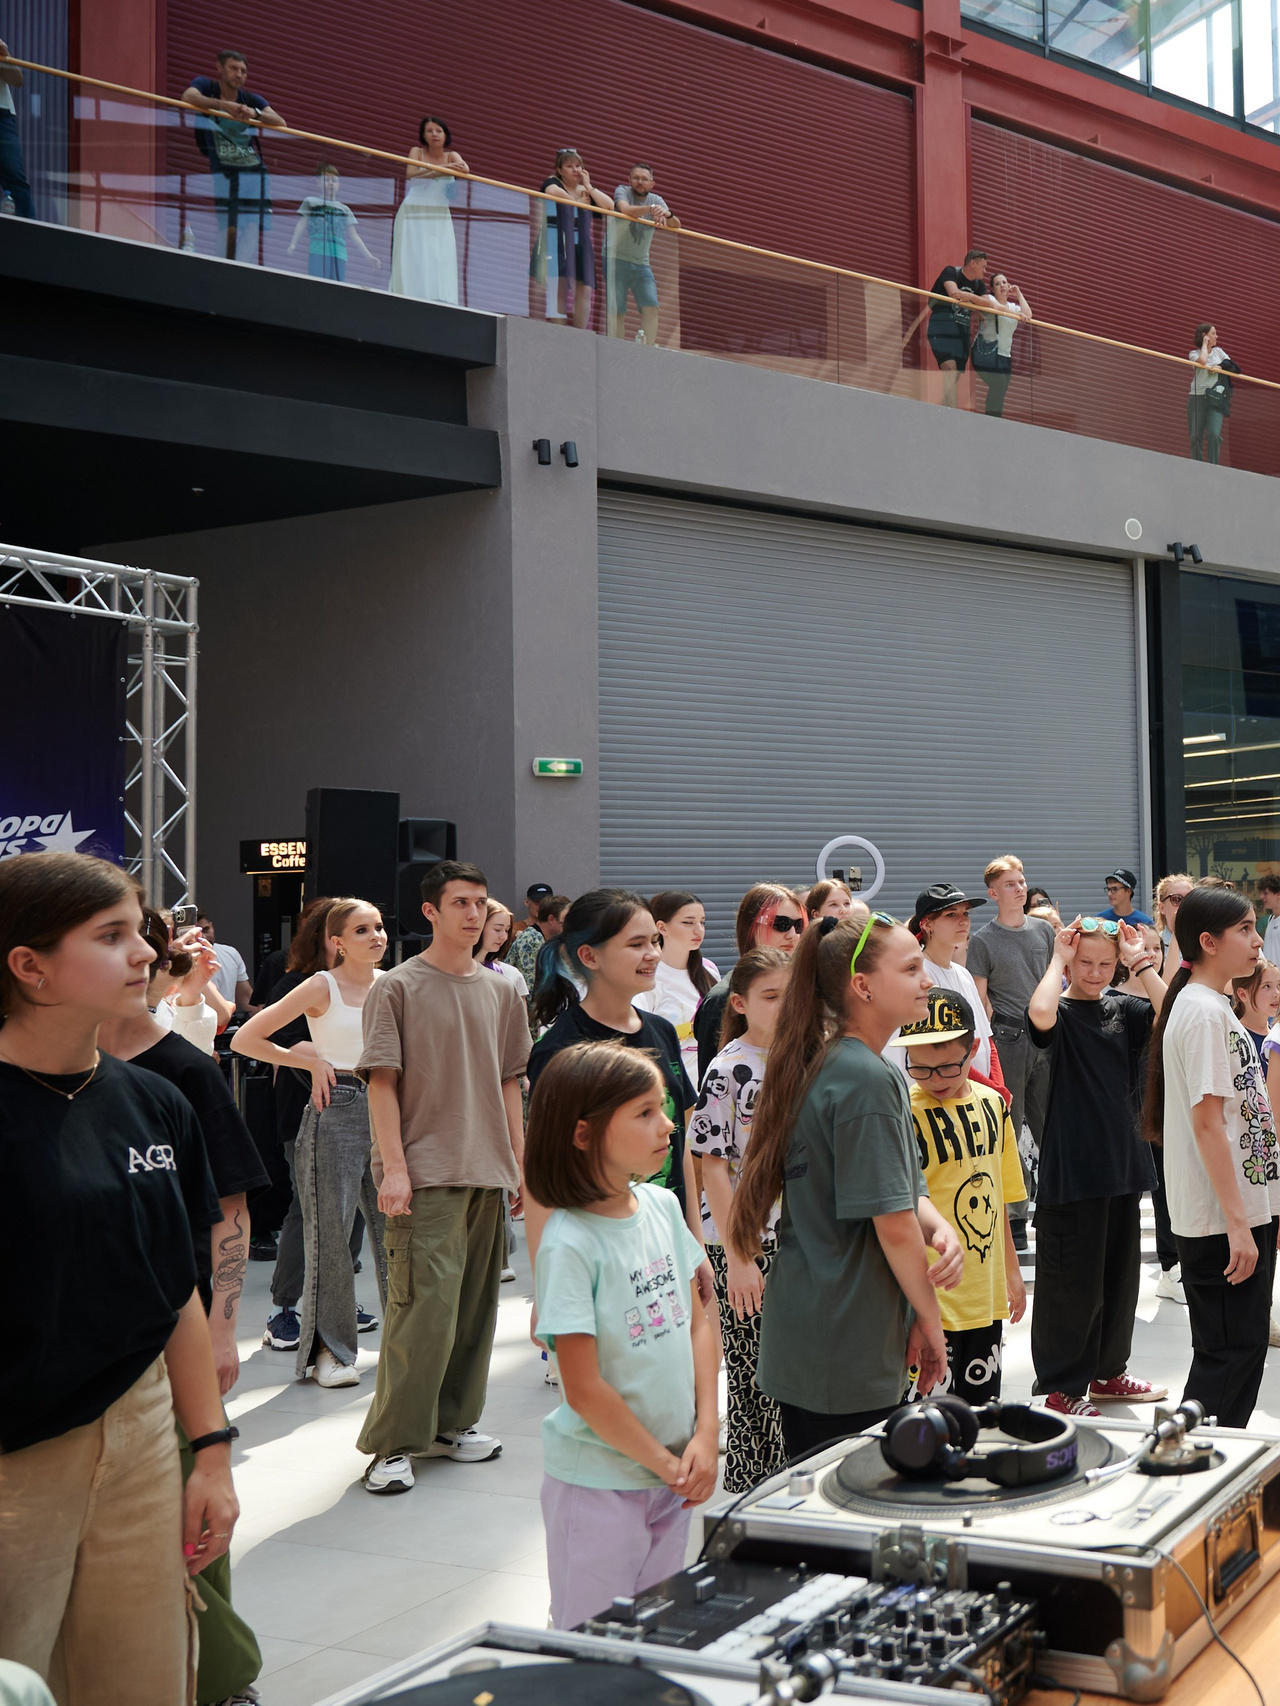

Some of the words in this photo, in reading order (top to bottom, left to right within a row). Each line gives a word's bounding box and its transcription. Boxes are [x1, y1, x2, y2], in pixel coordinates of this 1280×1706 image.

[260, 841, 307, 857] ESSEN
[272, 854, 306, 868] Coffe
[629, 1268, 644, 1285] MY
[635, 1269, 675, 1298] AWESOME
